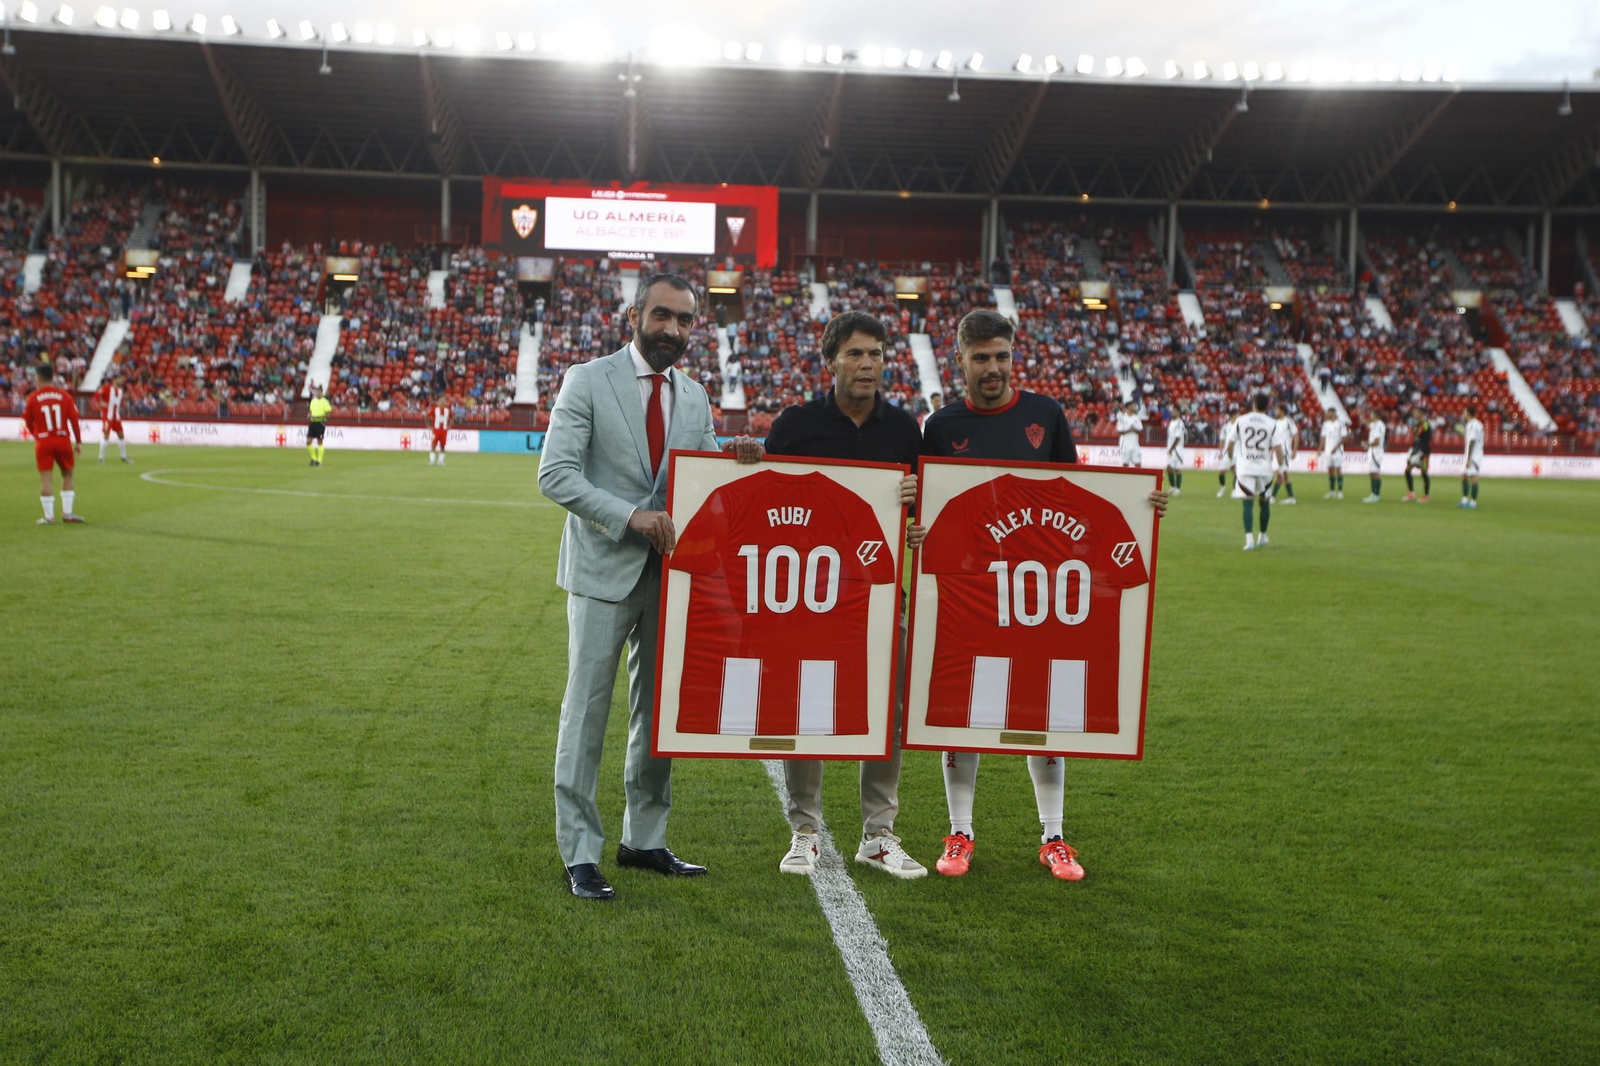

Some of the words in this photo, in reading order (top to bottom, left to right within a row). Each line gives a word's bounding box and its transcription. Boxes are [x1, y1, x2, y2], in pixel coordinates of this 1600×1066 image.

[573, 210, 598, 221] UD
[606, 210, 687, 223] ALMERÍA
[575, 226, 657, 238] ALBACETE
[664, 228, 685, 239] BP
[41, 404, 62, 431] 11
[1245, 426, 1268, 451] 22
[766, 506, 812, 528] RUBI
[1041, 508, 1086, 541] POZO
[737, 544, 841, 615] 100
[987, 559, 1092, 627] 100
